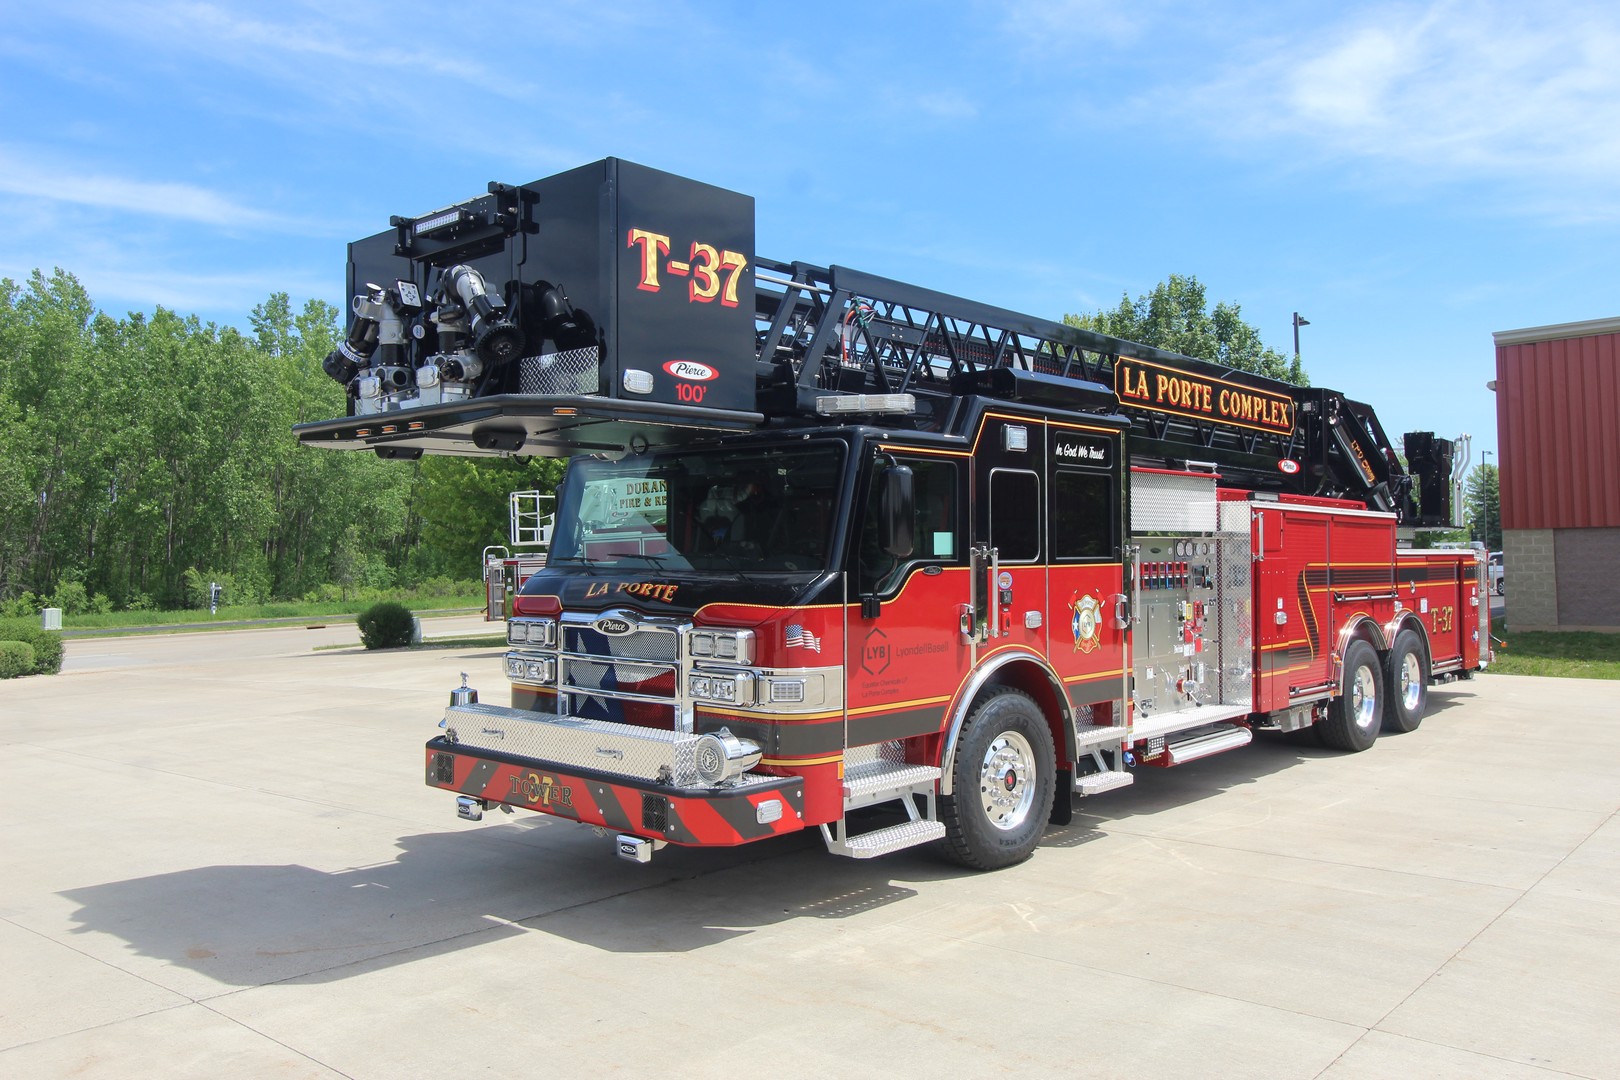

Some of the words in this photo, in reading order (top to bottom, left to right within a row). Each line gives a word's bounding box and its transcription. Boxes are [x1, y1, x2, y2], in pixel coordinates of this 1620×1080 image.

[628, 227, 748, 308] T-37
[676, 363, 706, 377] Pierce
[675, 383, 707, 403] 100'
[1123, 367, 1149, 400] LA
[1156, 374, 1213, 412] PORTE
[1219, 389, 1290, 428] COMPLEX
[1056, 443, 1063, 456] In
[1064, 443, 1078, 457] God
[1078, 445, 1088, 458] We
[1089, 446, 1105, 460] Trust
[584, 582, 610, 599] LA
[615, 582, 679, 604] PORTE
[601, 620, 626, 632] Pierce
[1430, 606, 1453, 634] T-37
[867, 646, 886, 660] LYB
[895, 641, 949, 657] LyondellBasell
[509, 774, 573, 807] TOWER
